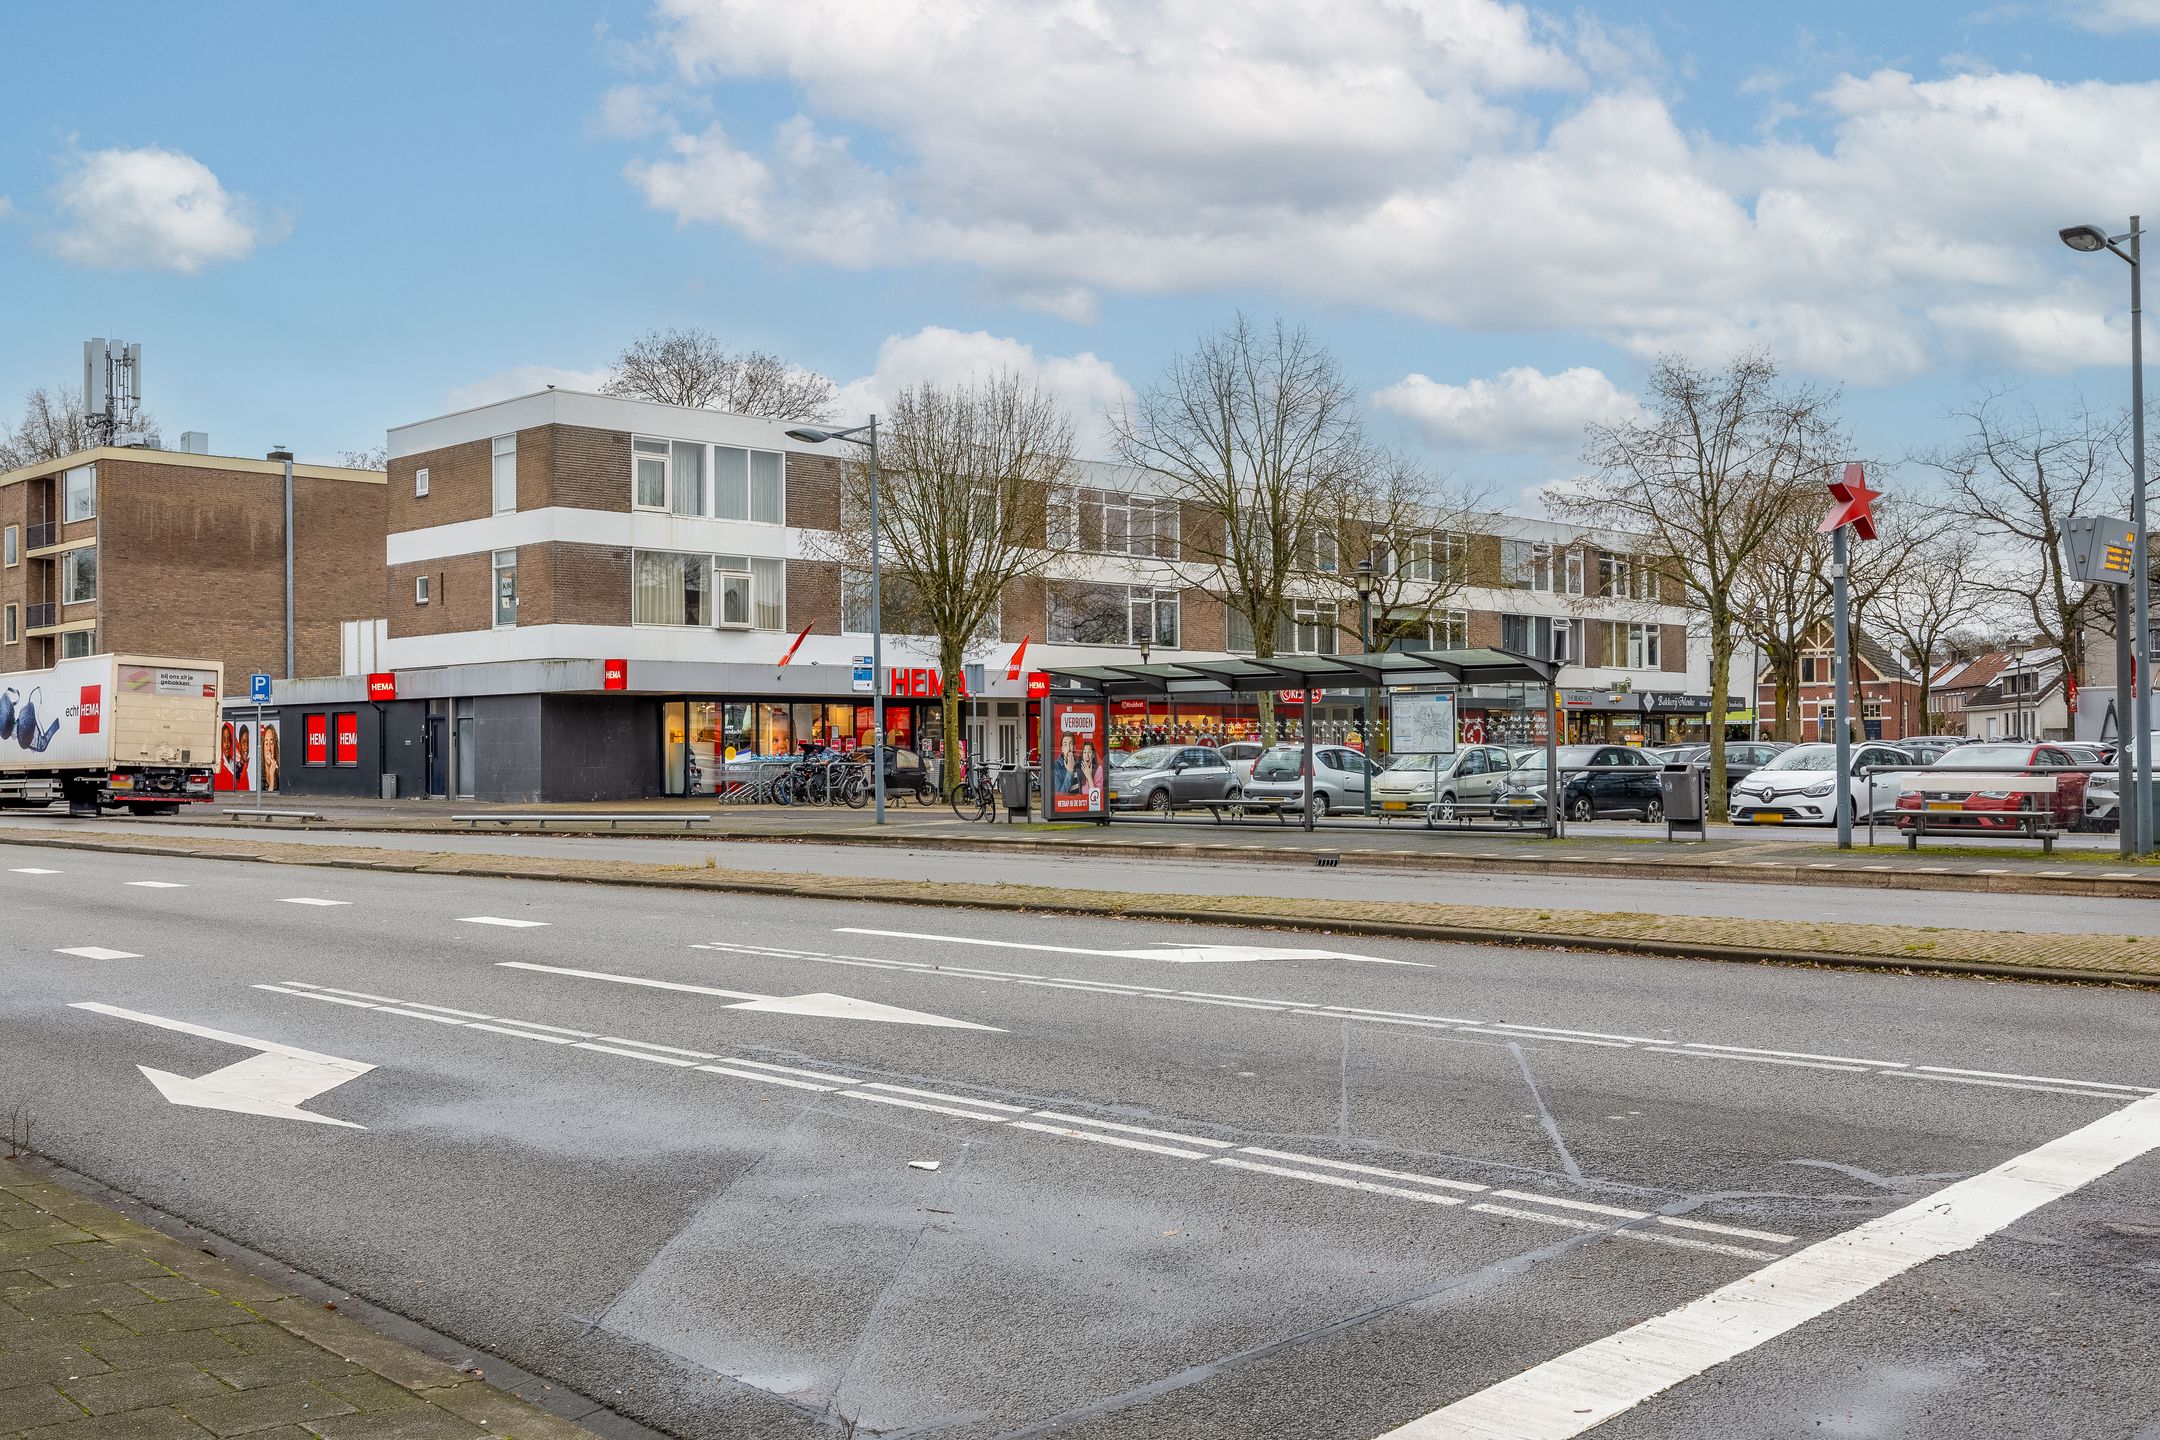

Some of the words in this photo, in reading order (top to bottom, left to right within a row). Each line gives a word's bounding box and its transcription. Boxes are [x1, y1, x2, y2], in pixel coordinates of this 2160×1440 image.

[606, 671, 621, 679] HEMA
[255, 676, 267, 691] P
[371, 683, 394, 691] HEMA
[65, 704, 80, 717] echt
[80, 703, 100, 717] HEMA
[1064, 717, 1093, 728] VERBODEN
